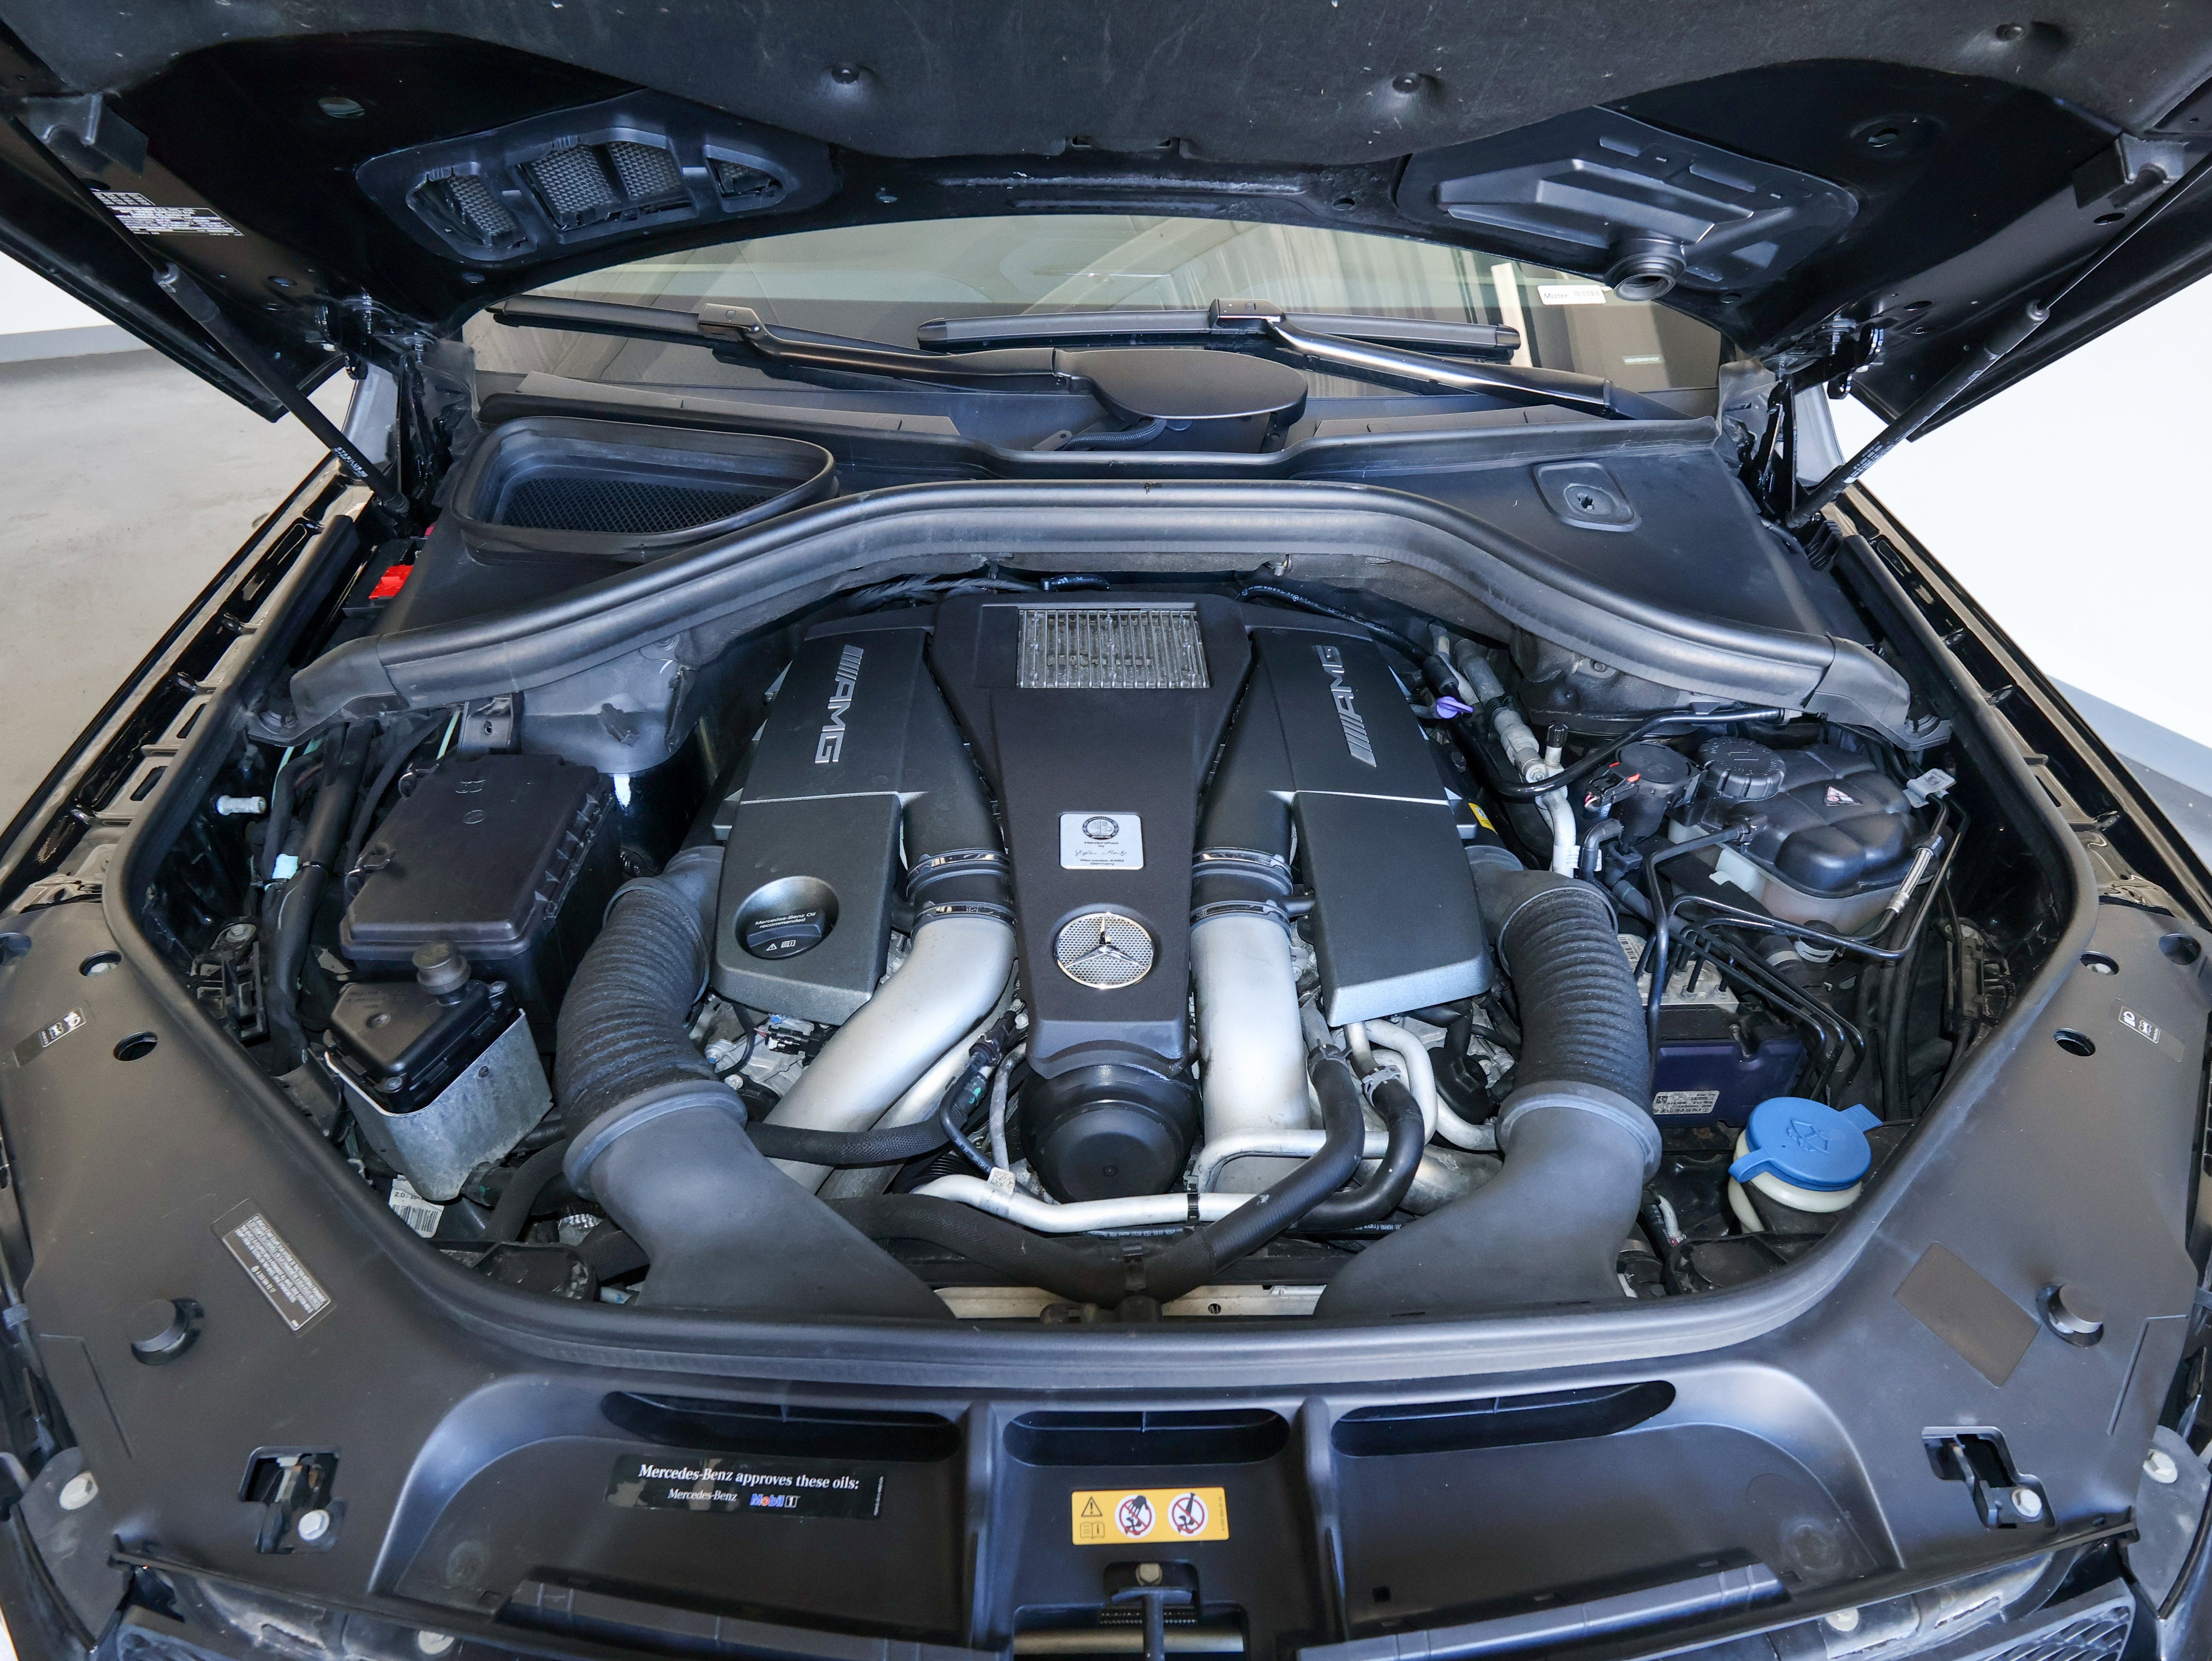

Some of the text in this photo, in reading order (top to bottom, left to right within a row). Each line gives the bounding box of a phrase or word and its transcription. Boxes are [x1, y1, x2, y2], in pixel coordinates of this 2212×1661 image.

[815, 677, 856, 764] AMG
[754, 914, 805, 926] Mercedes-Benz
[759, 918, 806, 928] recommended
[638, 1464, 859, 1490] Mercedes-Benz approves these oils:
[667, 1488, 738, 1502] Mercedes-Benz
[749, 1493, 785, 1507] Mobil
